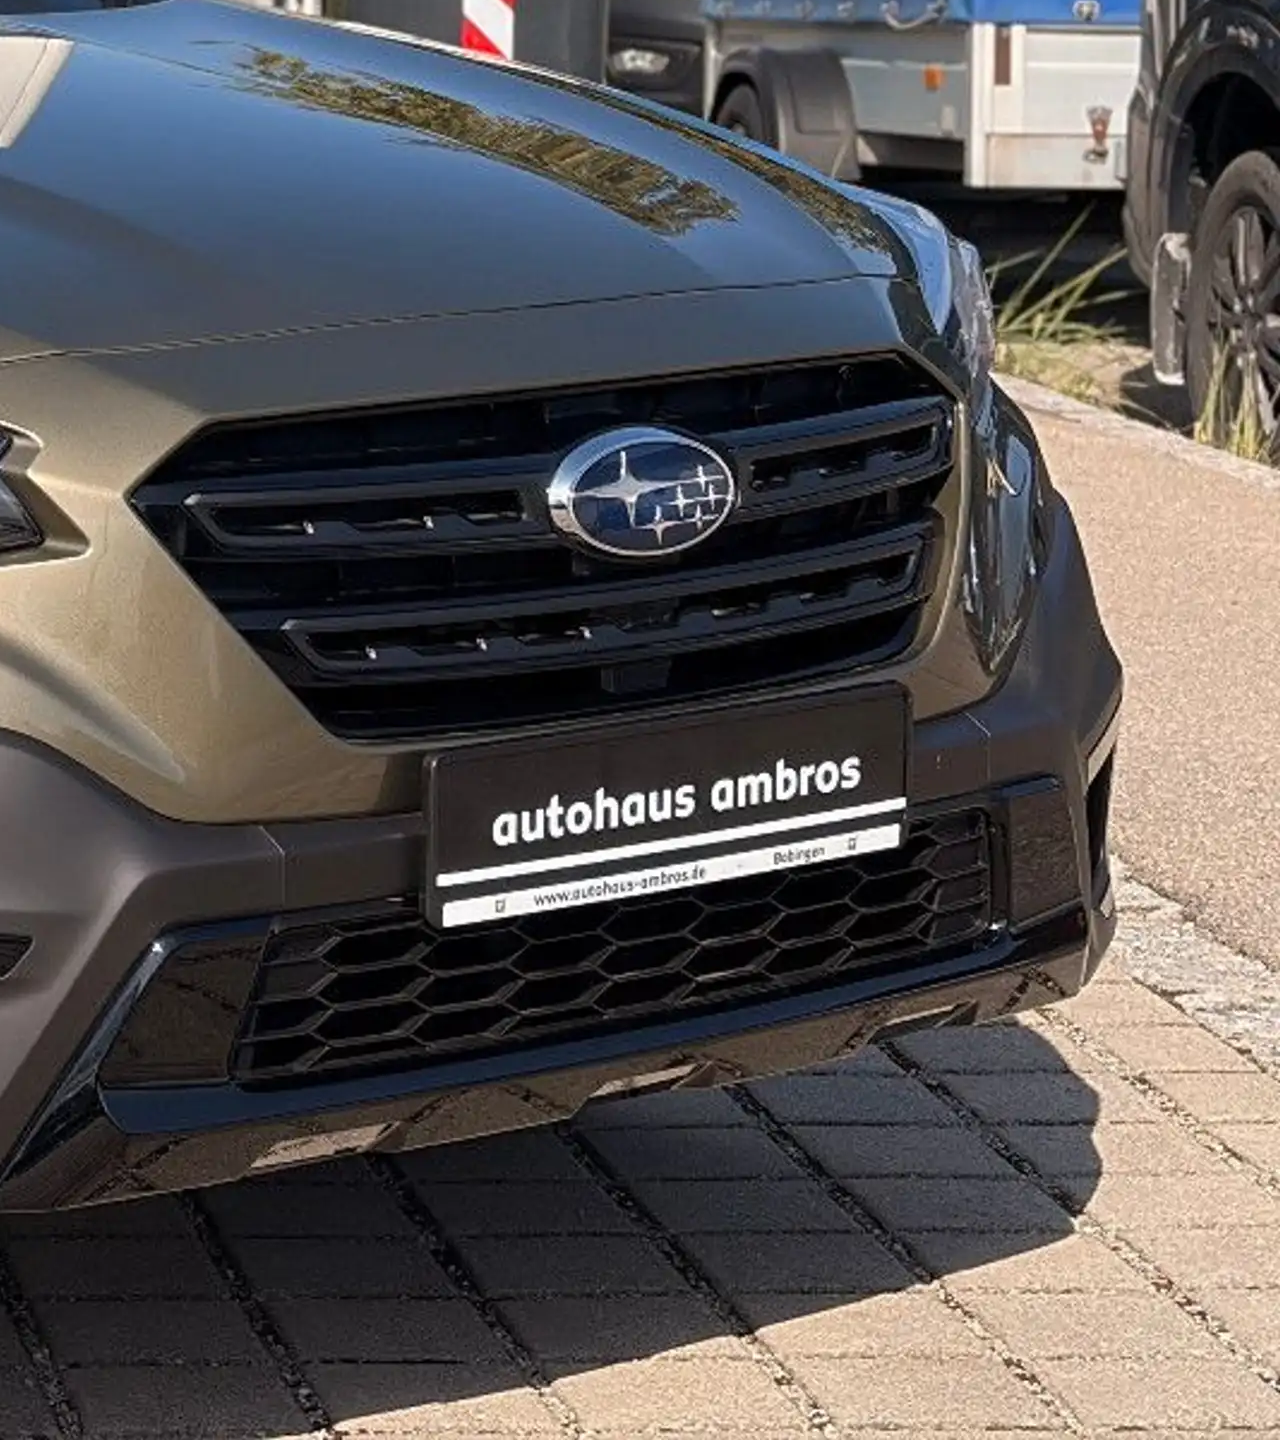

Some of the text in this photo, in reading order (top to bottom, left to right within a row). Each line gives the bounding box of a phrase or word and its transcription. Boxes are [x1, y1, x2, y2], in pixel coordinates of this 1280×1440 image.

[491, 755, 862, 848] autohaus ambros
[532, 863, 707, 907] www.autohaus-ambros.de
